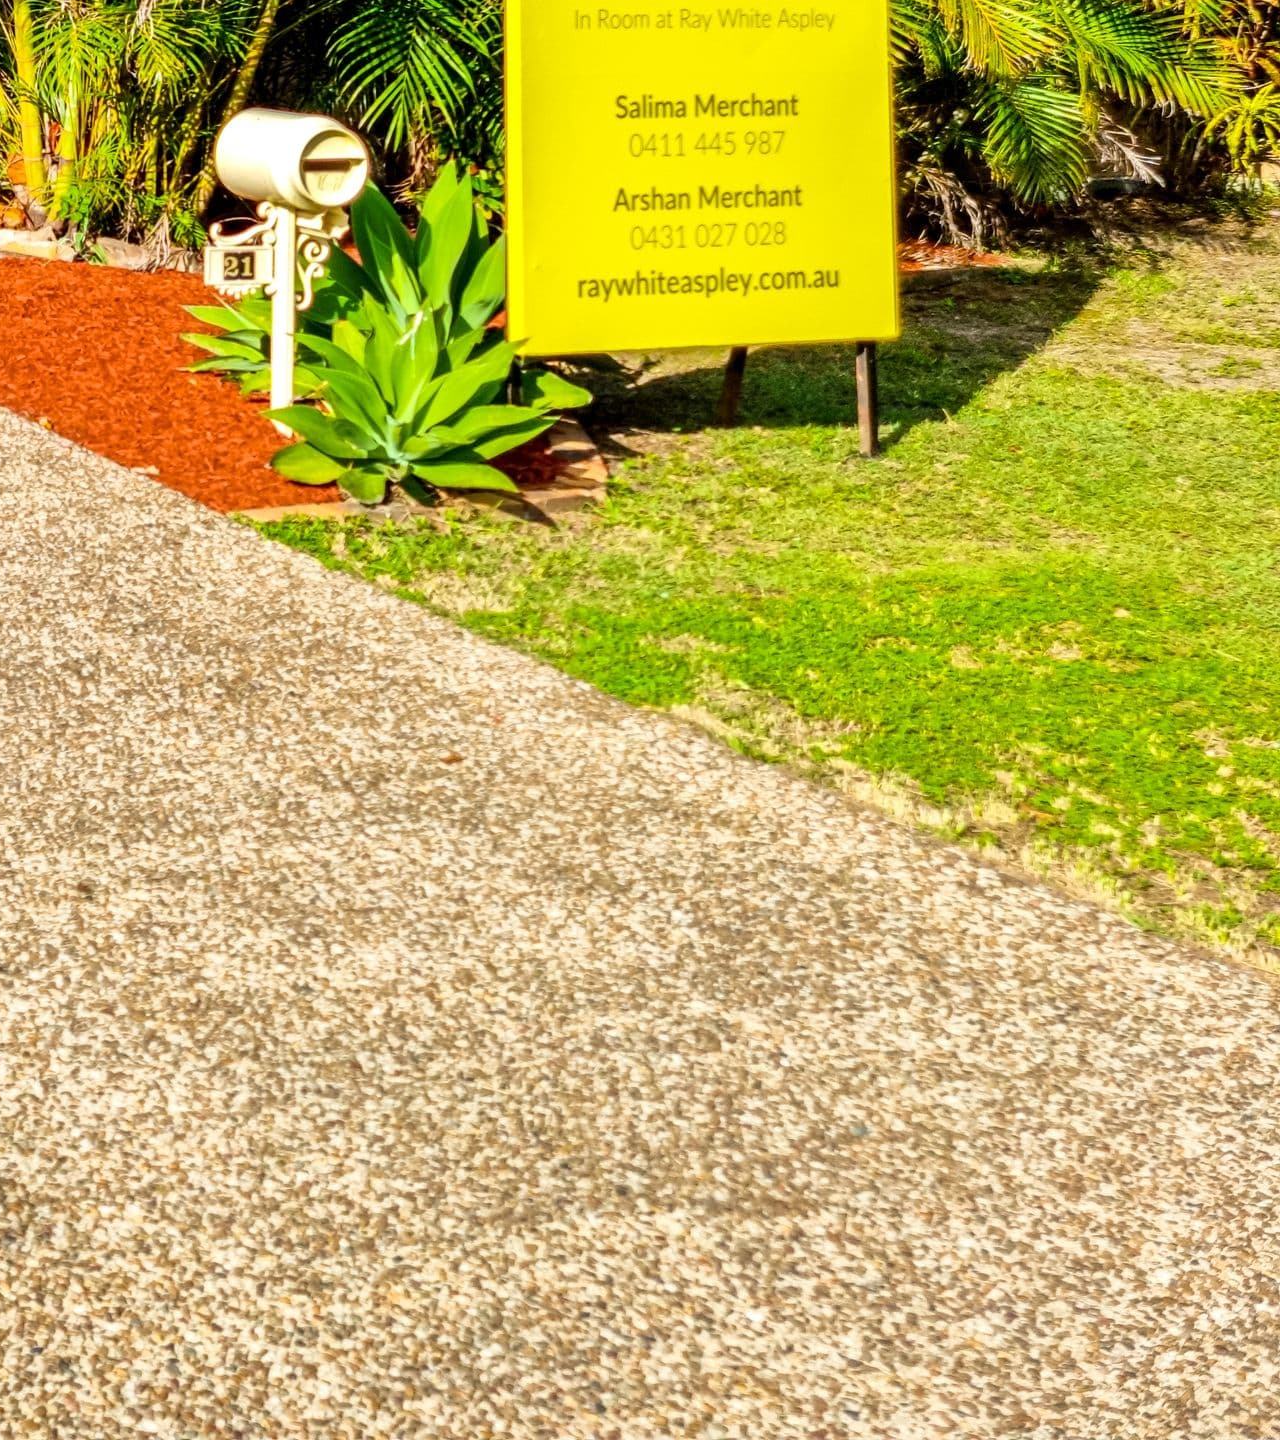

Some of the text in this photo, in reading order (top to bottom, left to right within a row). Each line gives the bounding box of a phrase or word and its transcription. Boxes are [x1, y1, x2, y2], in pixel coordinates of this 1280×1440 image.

[575, 7, 835, 32] In Room at Ray White Aspley
[615, 93, 799, 120] Salima Merchant
[629, 130, 785, 158] 0411 445 987
[613, 184, 802, 212] Arshan Merchant
[630, 221, 786, 250] 0431 027 028
[224, 255, 253, 278] 21
[578, 267, 840, 303] raywhiteaspley.com.au
